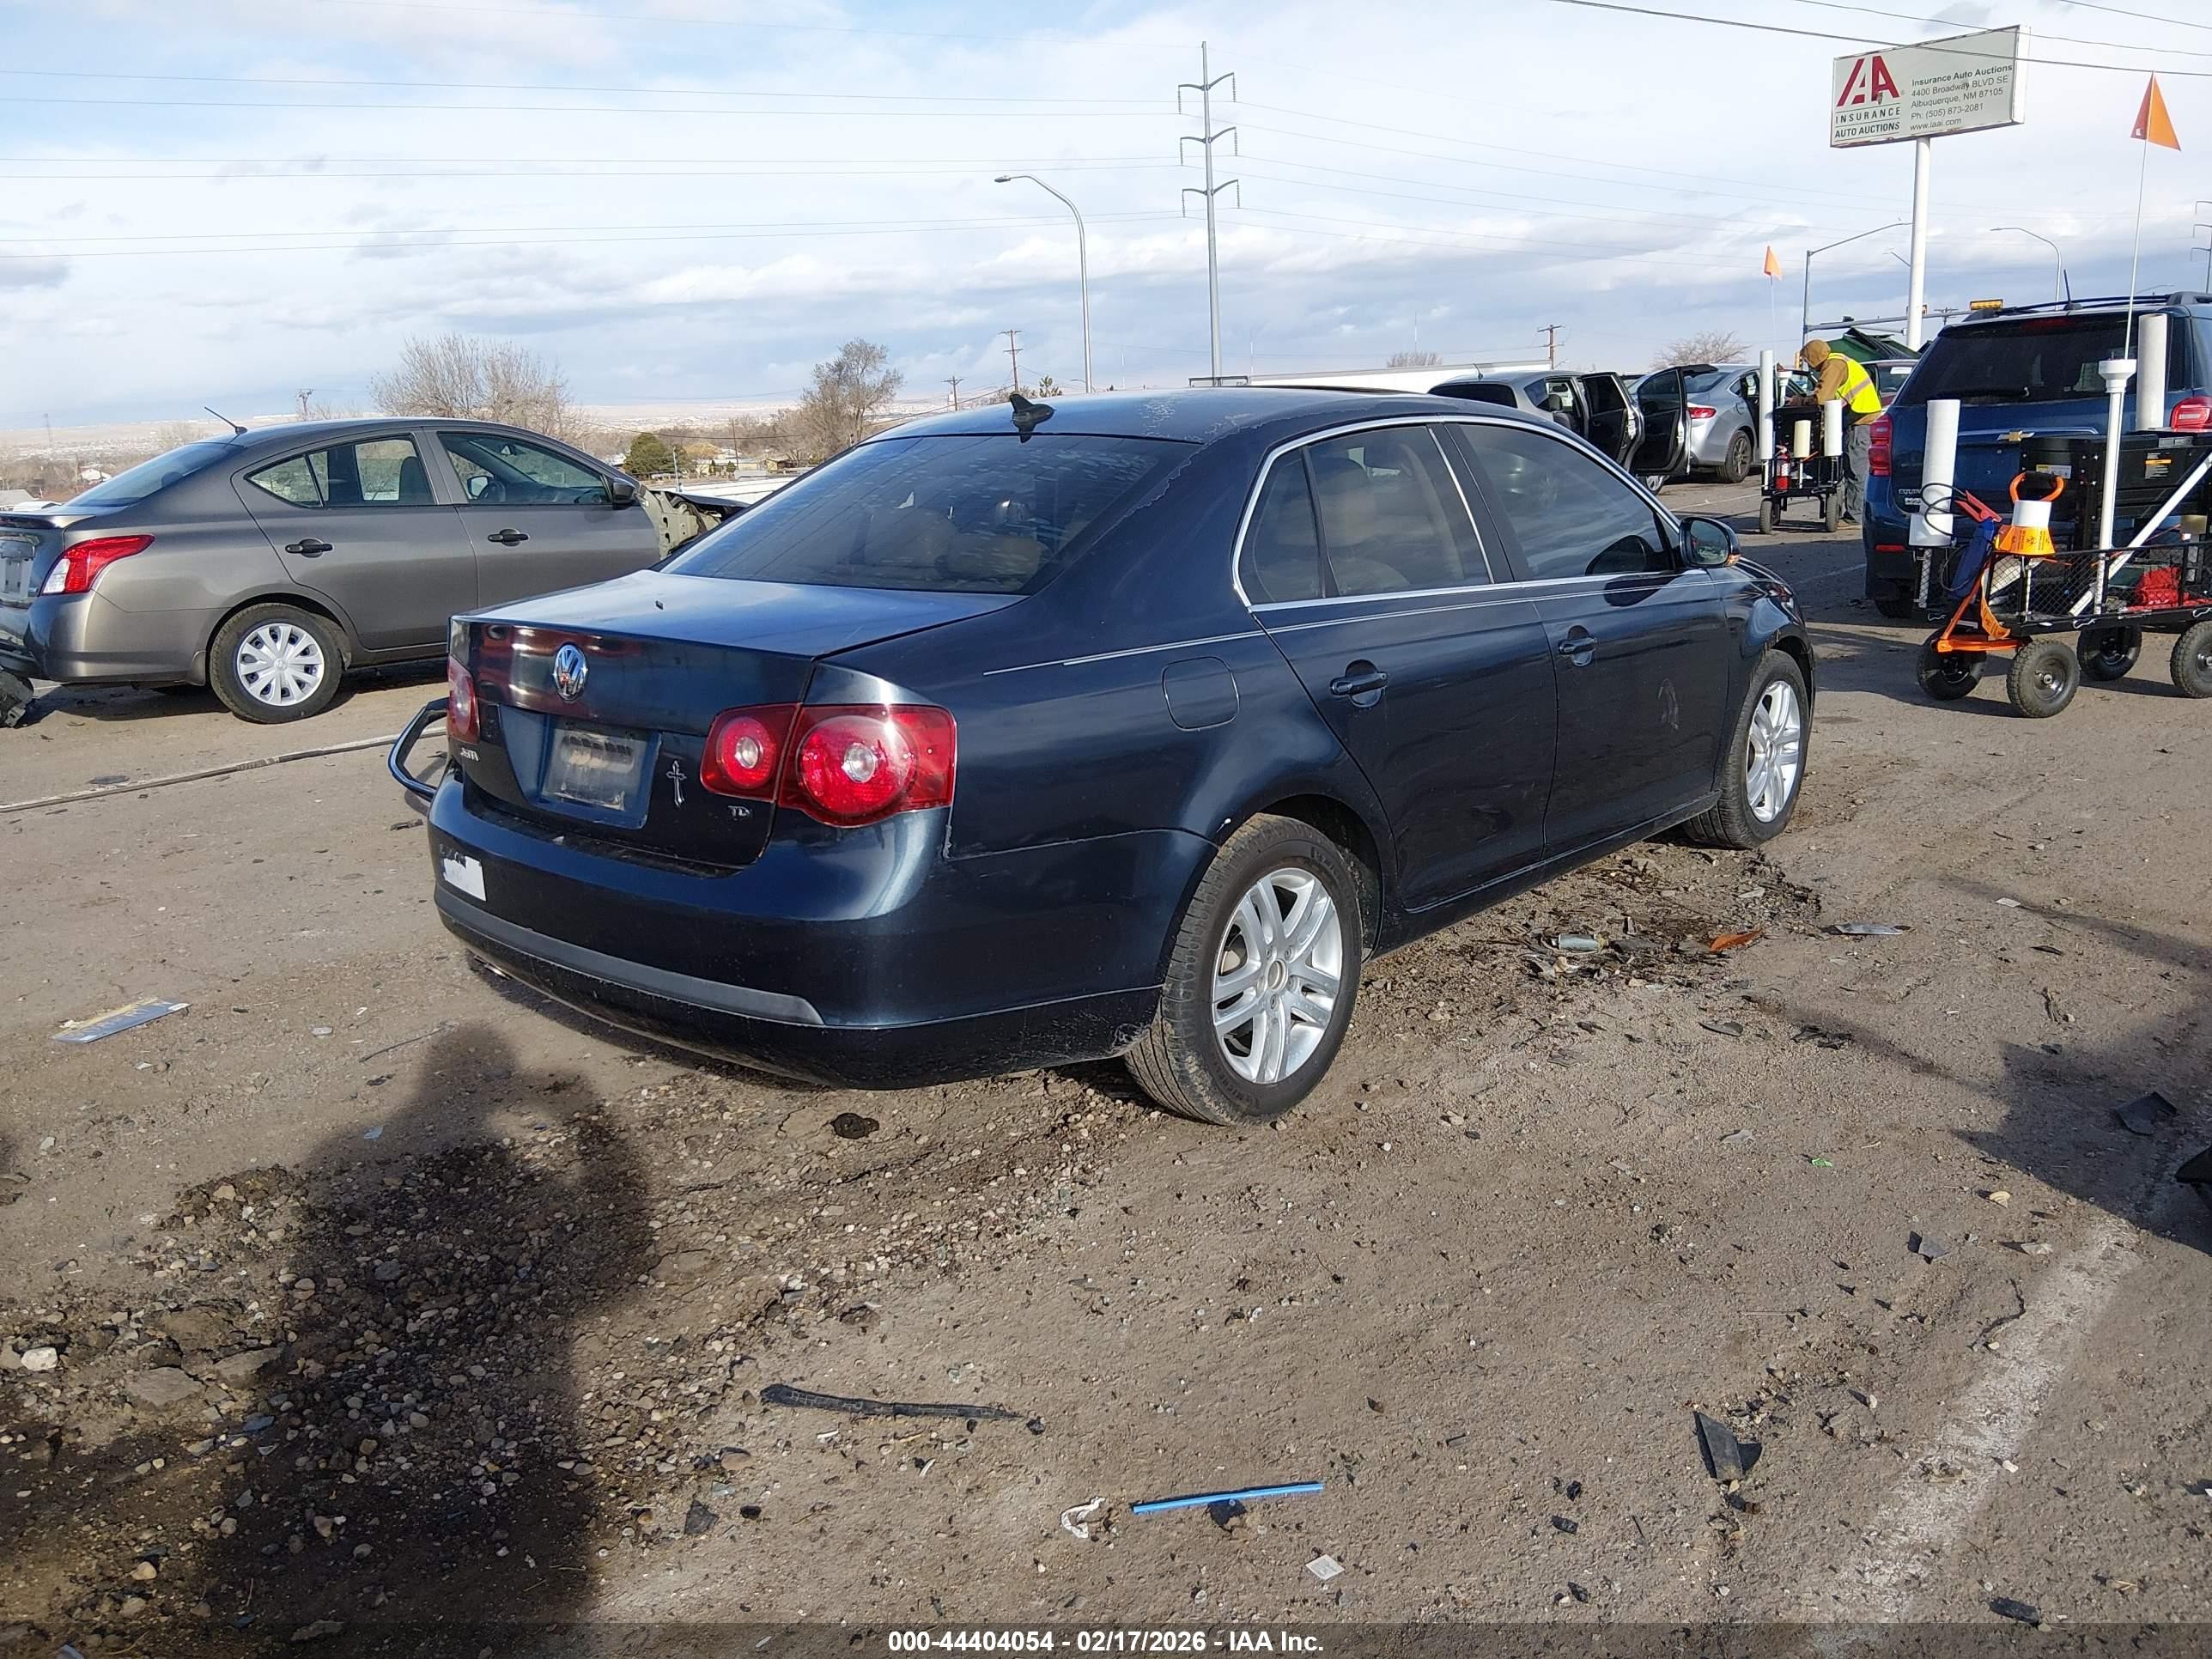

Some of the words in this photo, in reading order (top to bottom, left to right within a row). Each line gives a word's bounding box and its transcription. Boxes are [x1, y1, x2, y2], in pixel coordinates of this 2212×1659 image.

[1911, 75, 1952, 87] Insurance
[1953, 71, 1973, 80] Auto
[1974, 64, 2013, 76] Auctions
[1911, 88, 1930, 97] 4400
[1932, 82, 1970, 94] Broadway
[1972, 77, 1994, 88] BLVD
[1996, 75, 2008, 84] SE
[1911, 95, 1961, 108] Albuquerque,
[1963, 92, 1977, 100] NM
[1978, 87, 2003, 98] 87105
[1835, 106, 1901, 124] INSURANCE
[1925, 108, 1946, 119] (505)
[1948, 103, 1984, 115] 873-2081
[1834, 128, 1856, 138] AUTO
[1858, 121, 1900, 135] AUCTIONS
[1910, 118, 1962, 131] www.iaai.com
